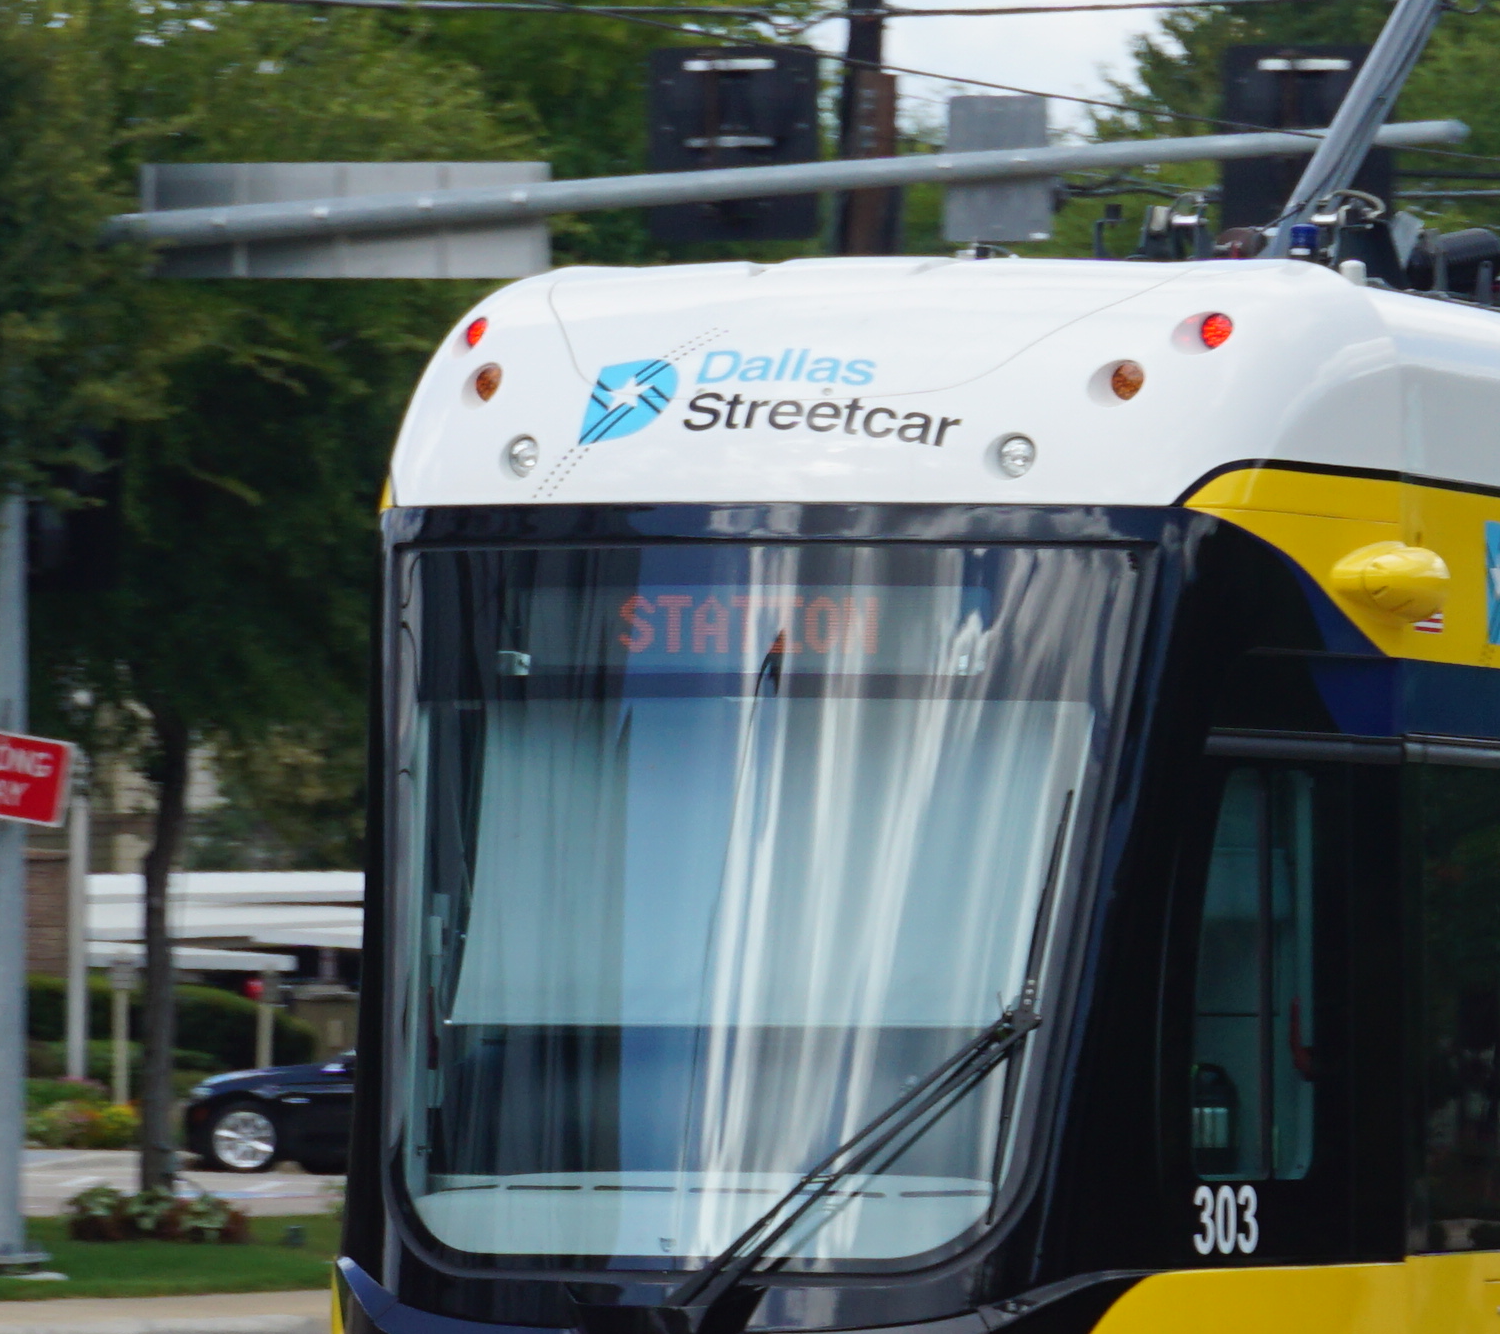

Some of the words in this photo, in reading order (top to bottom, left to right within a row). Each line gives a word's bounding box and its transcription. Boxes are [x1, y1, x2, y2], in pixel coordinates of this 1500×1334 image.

[695, 348, 877, 386] Dallas
[682, 392, 963, 447] Streetcar
[618, 595, 878, 654] STATION
[1193, 1185, 1259, 1255] 303
